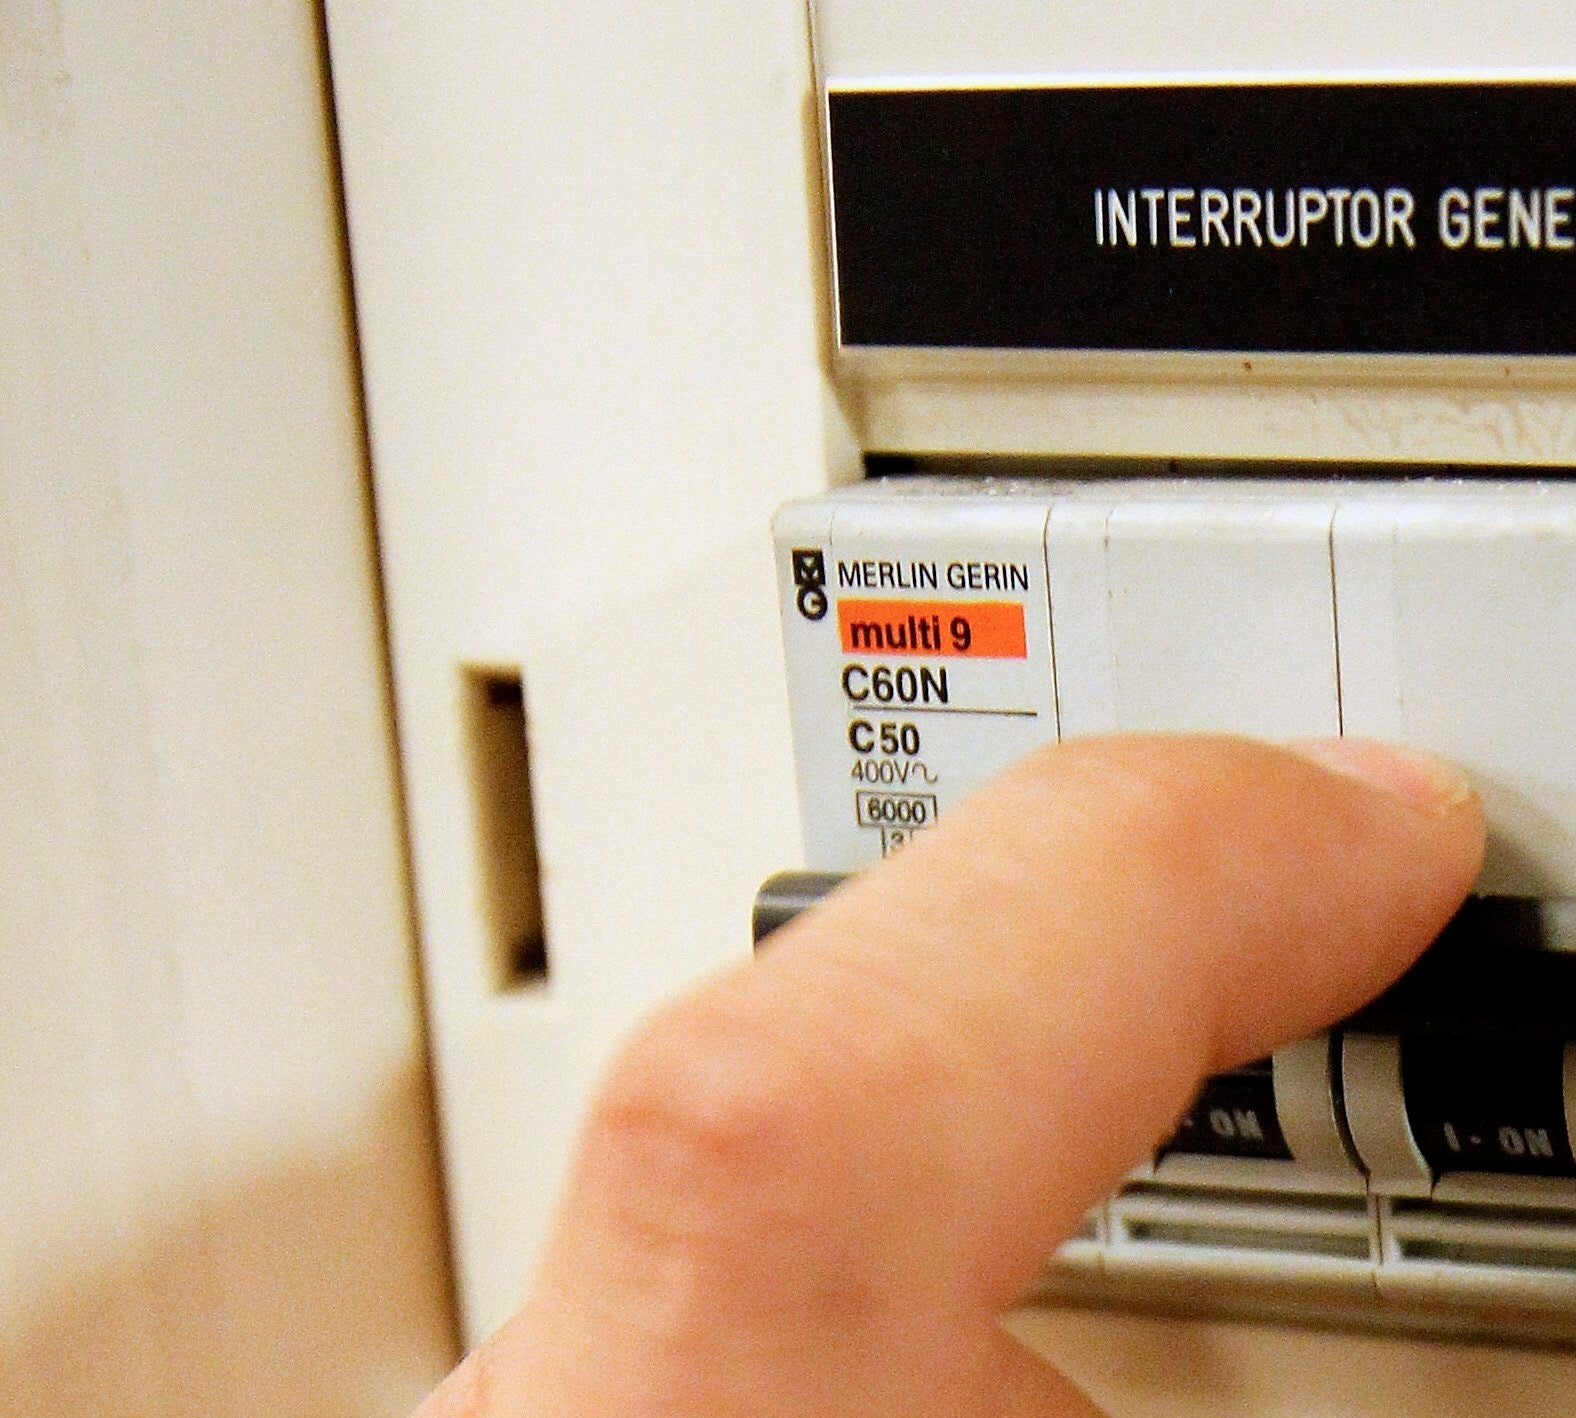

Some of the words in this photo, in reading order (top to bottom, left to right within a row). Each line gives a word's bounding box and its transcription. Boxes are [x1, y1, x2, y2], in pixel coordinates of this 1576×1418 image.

[1094, 187, 1416, 250] INTERRUPTOR
[838, 561, 938, 590] MERLIN
[947, 563, 1029, 591] GERIN
[851, 616, 941, 651] multi
[950, 617, 972, 652] 9
[842, 664, 949, 704] C60N
[849, 720, 920, 756] C50
[867, 797, 926, 823] 6000
[1209, 1109, 1264, 1140] ON
[1499, 1126, 1554, 1157] ON
